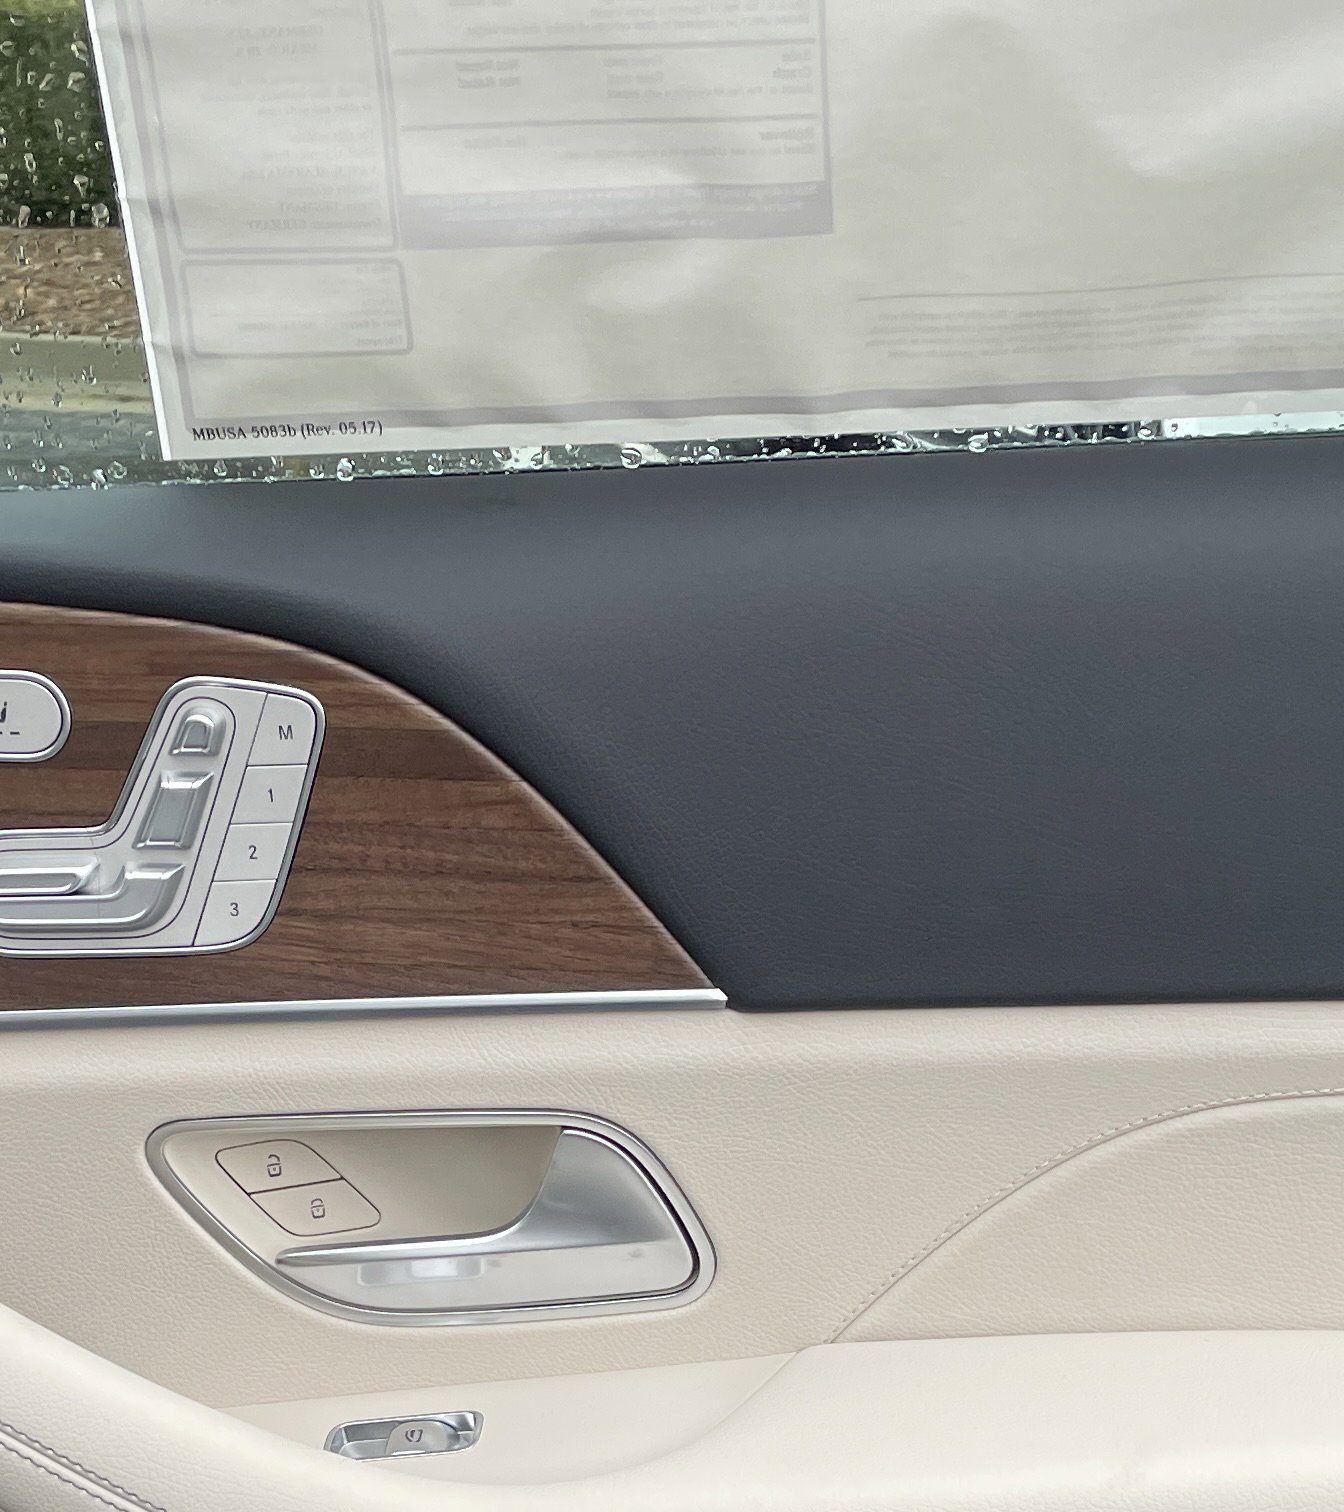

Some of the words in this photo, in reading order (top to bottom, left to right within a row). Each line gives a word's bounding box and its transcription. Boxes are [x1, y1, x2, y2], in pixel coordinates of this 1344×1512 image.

[192, 427, 248, 441] MBUSA
[301, 423, 335, 440] (Rev.
[338, 420, 383, 437] 05.17)
[278, 724, 294, 741] M
[267, 788, 274, 803] 1
[248, 844, 258, 860] 2
[229, 902, 240, 917] 3
